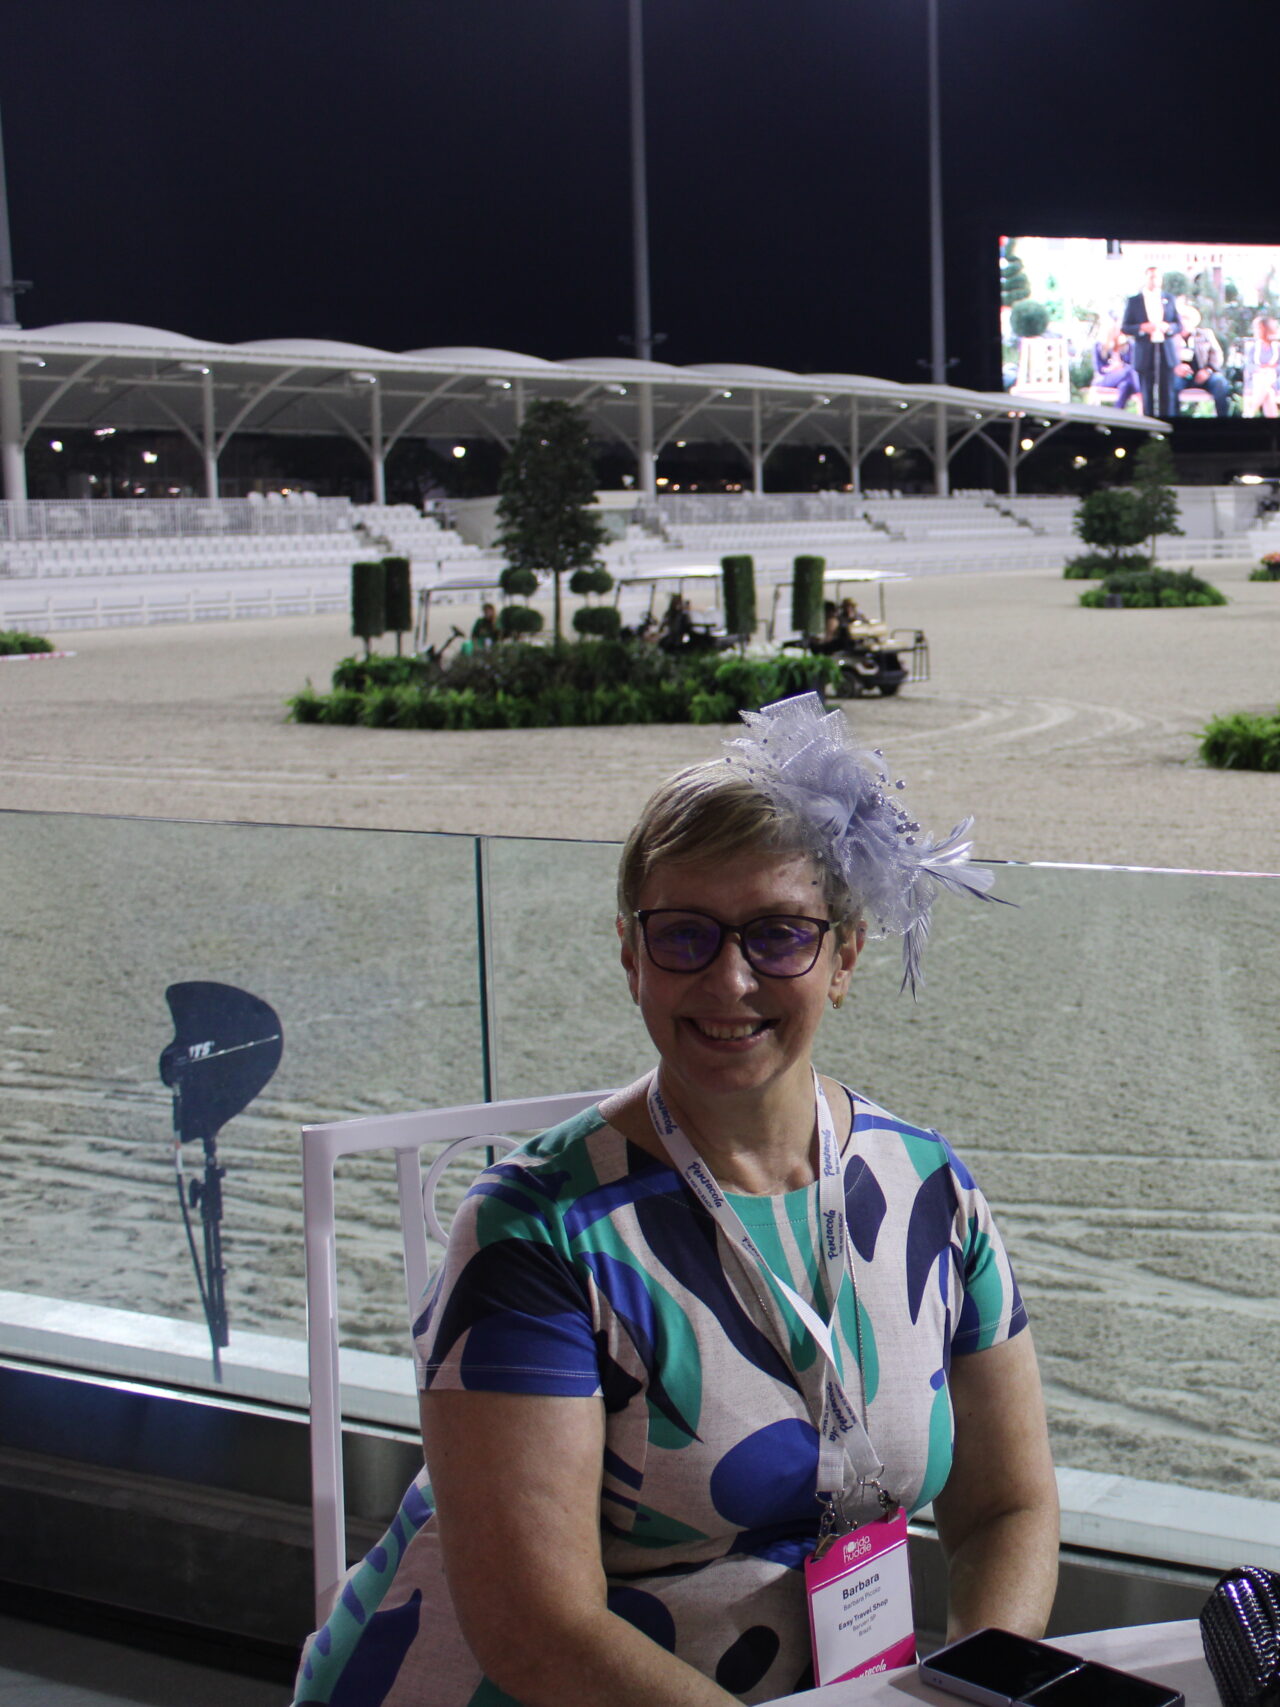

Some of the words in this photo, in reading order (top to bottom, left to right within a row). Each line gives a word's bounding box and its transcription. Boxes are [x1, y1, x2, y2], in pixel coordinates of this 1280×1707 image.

[822, 1128, 836, 1177] Pensacola
[688, 1161, 724, 1208] Pensacola
[823, 1209, 838, 1260] Pensacola
[826, 1381, 854, 1433] Pensacola
[843, 1543, 872, 1564] huddle
[842, 1573, 880, 1600] Barbara
[838, 1619, 854, 1631] Easy
[854, 1606, 872, 1621] Travel
[872, 1598, 888, 1611] Shop
